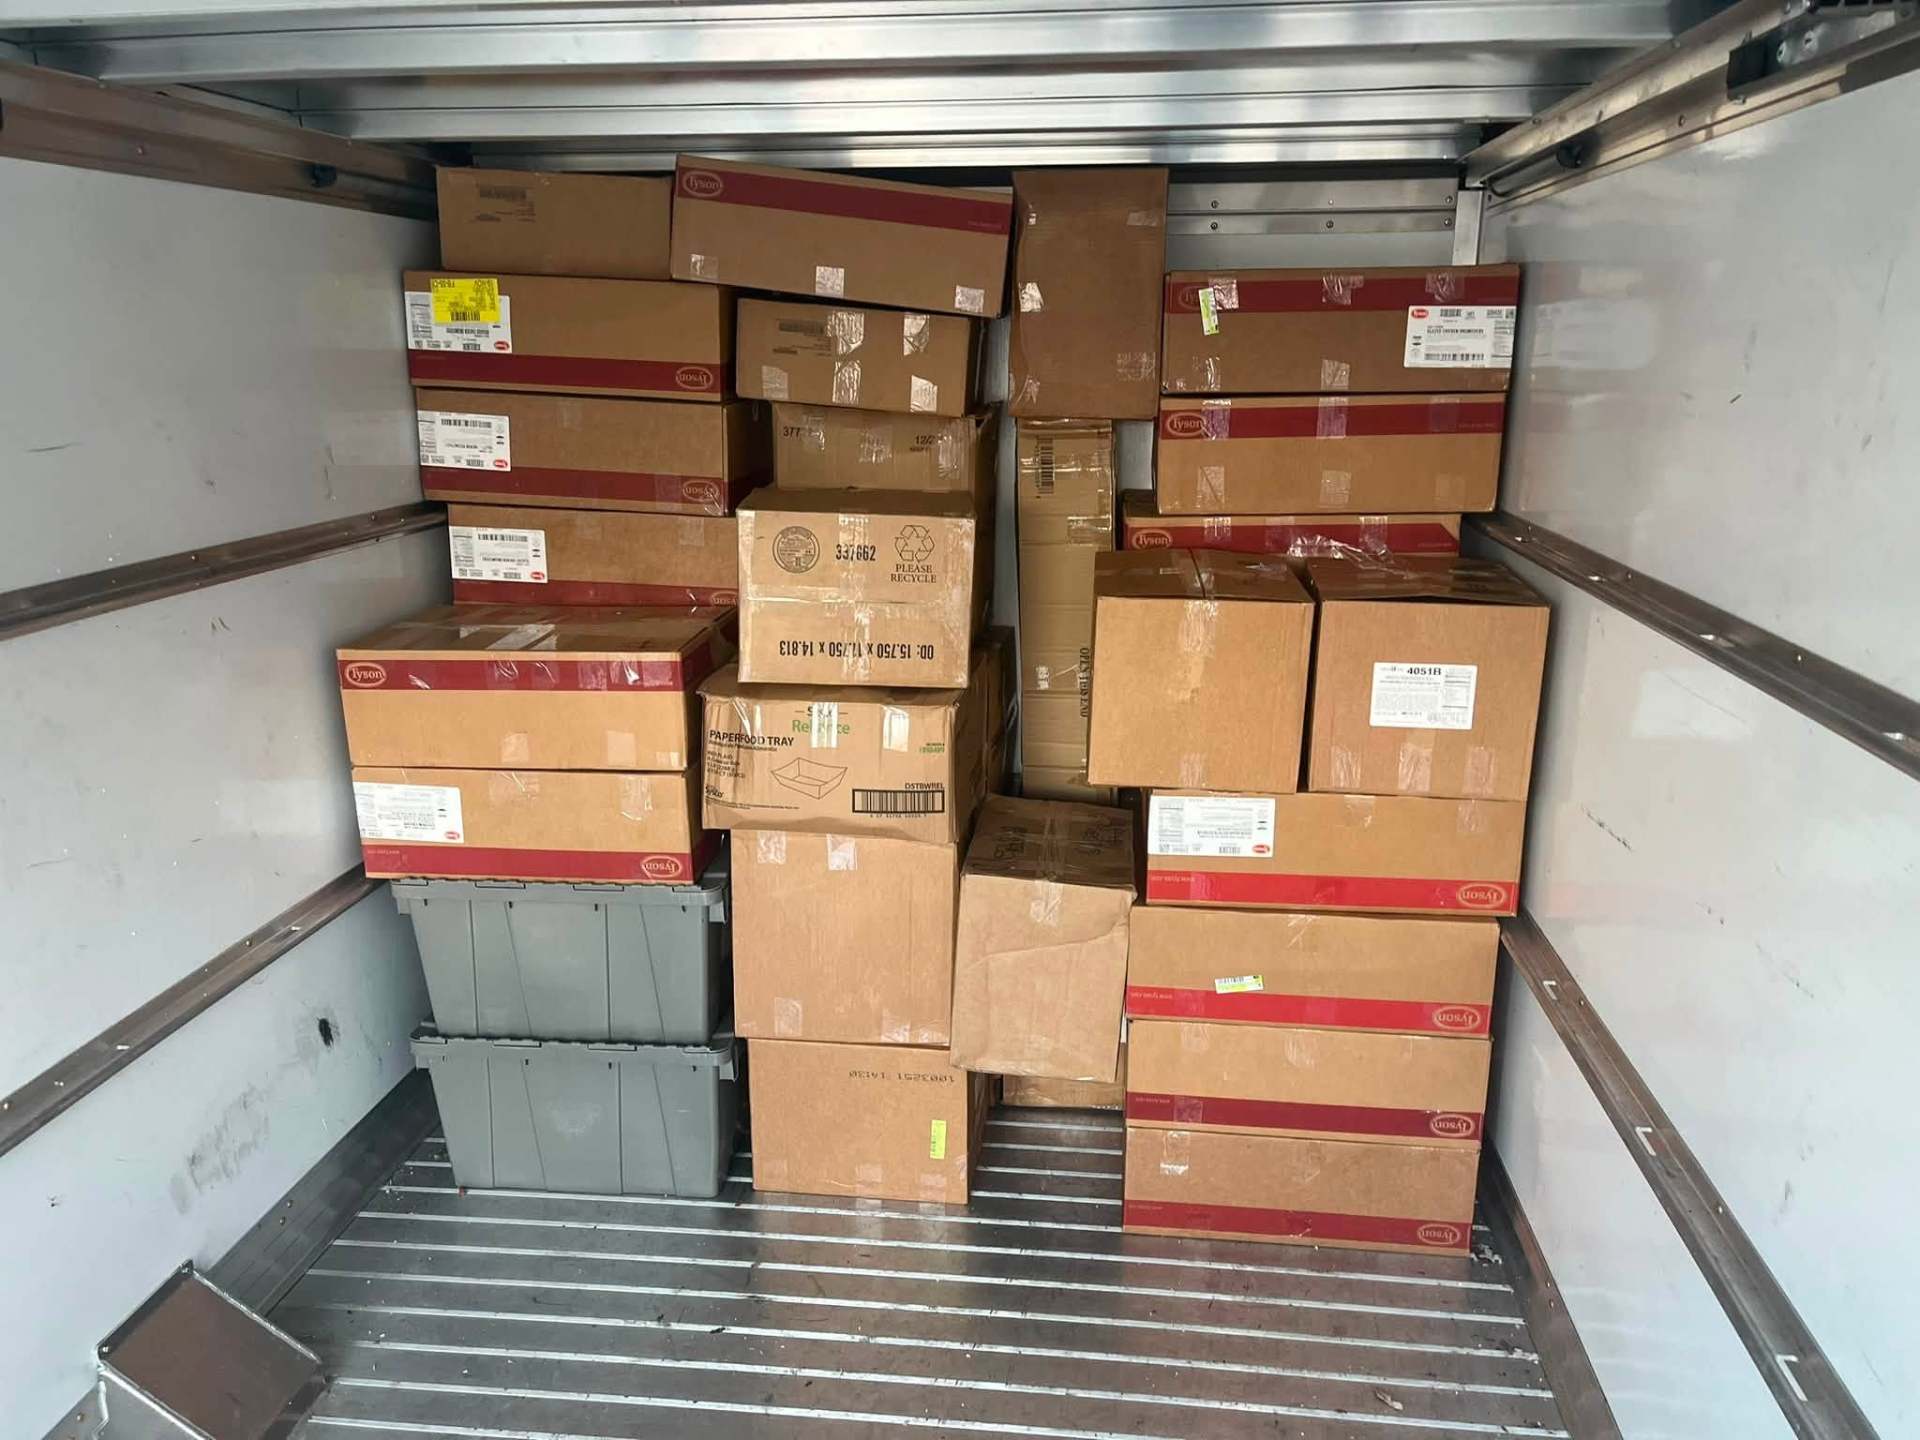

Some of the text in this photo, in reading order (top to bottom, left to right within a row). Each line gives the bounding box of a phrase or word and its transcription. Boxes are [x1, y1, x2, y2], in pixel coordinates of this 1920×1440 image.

[688, 174, 721, 190] Tyson
[895, 563, 933, 574] PLEASE
[890, 573, 937, 584] RECYCLE
[779, 640, 814, 656] 14.813
[877, 643, 912, 659] 15.750
[1078, 647, 1090, 672] OPEN
[350, 667, 384, 681] Tyson
[768, 735, 794, 747] TRAY
[643, 860, 677, 874] Tyson
[1462, 887, 1502, 904] Tyson
[1437, 1011, 1474, 1026] Tyson
[1434, 1119, 1469, 1133] Tyson
[1421, 1229, 1454, 1242] Tyson
